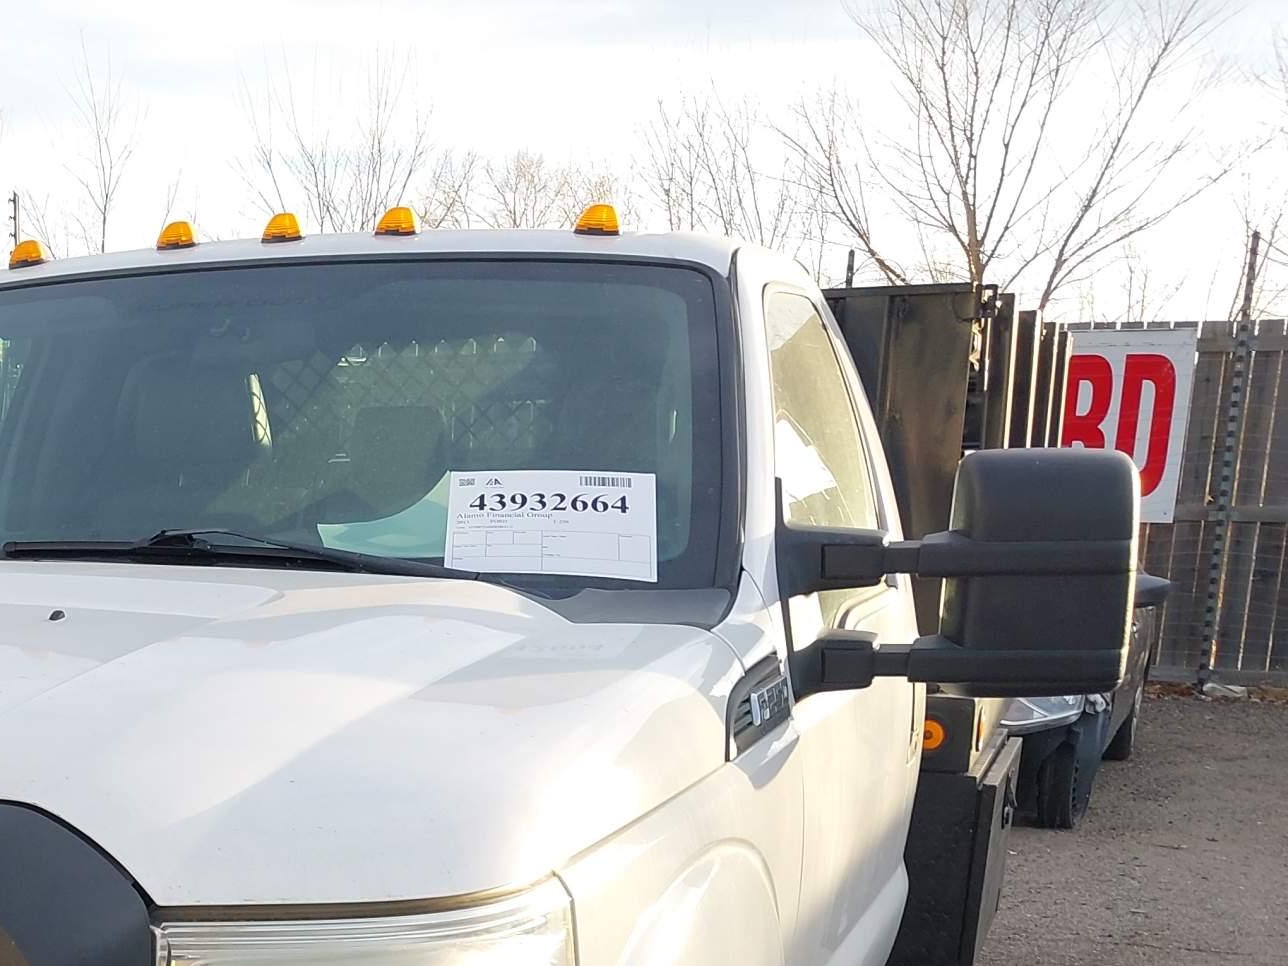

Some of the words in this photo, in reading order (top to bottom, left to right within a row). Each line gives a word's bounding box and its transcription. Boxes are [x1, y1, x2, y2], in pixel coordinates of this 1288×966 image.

[469, 493, 630, 514] 43932664
[456, 512, 484, 520] Alamo
[486, 511, 524, 519] Financial
[526, 511, 553, 520] Group
